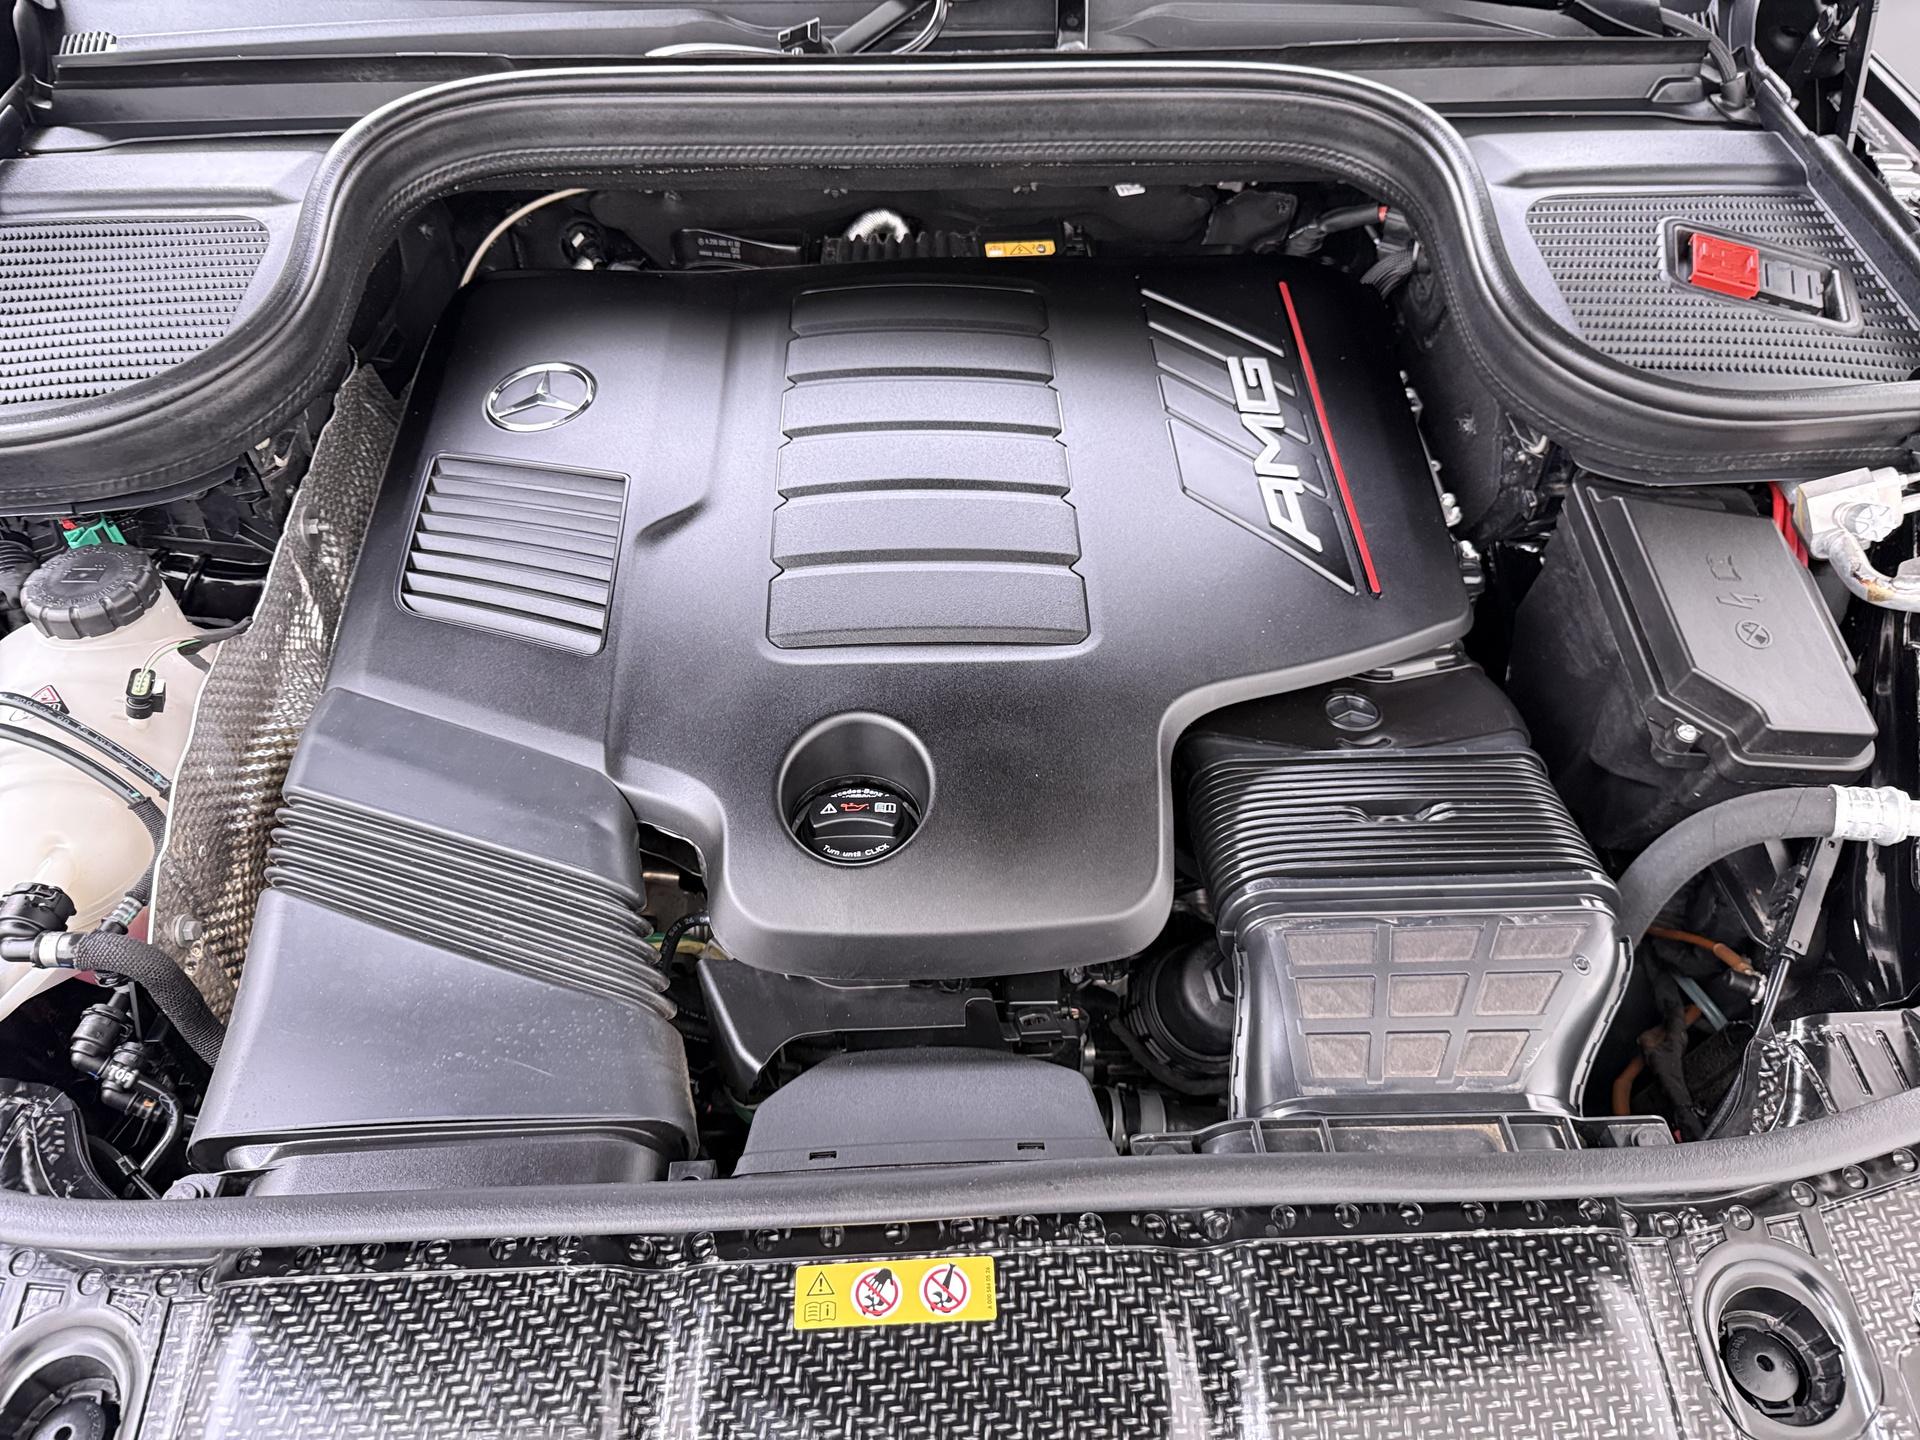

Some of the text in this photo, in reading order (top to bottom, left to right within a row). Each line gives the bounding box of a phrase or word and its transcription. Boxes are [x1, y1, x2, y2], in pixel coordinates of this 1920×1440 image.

[1225, 356, 1323, 552] AMG
[823, 844, 840, 856] Turn
[864, 843, 890, 856] CLICK
[108, 1064, 134, 1083] TOP
